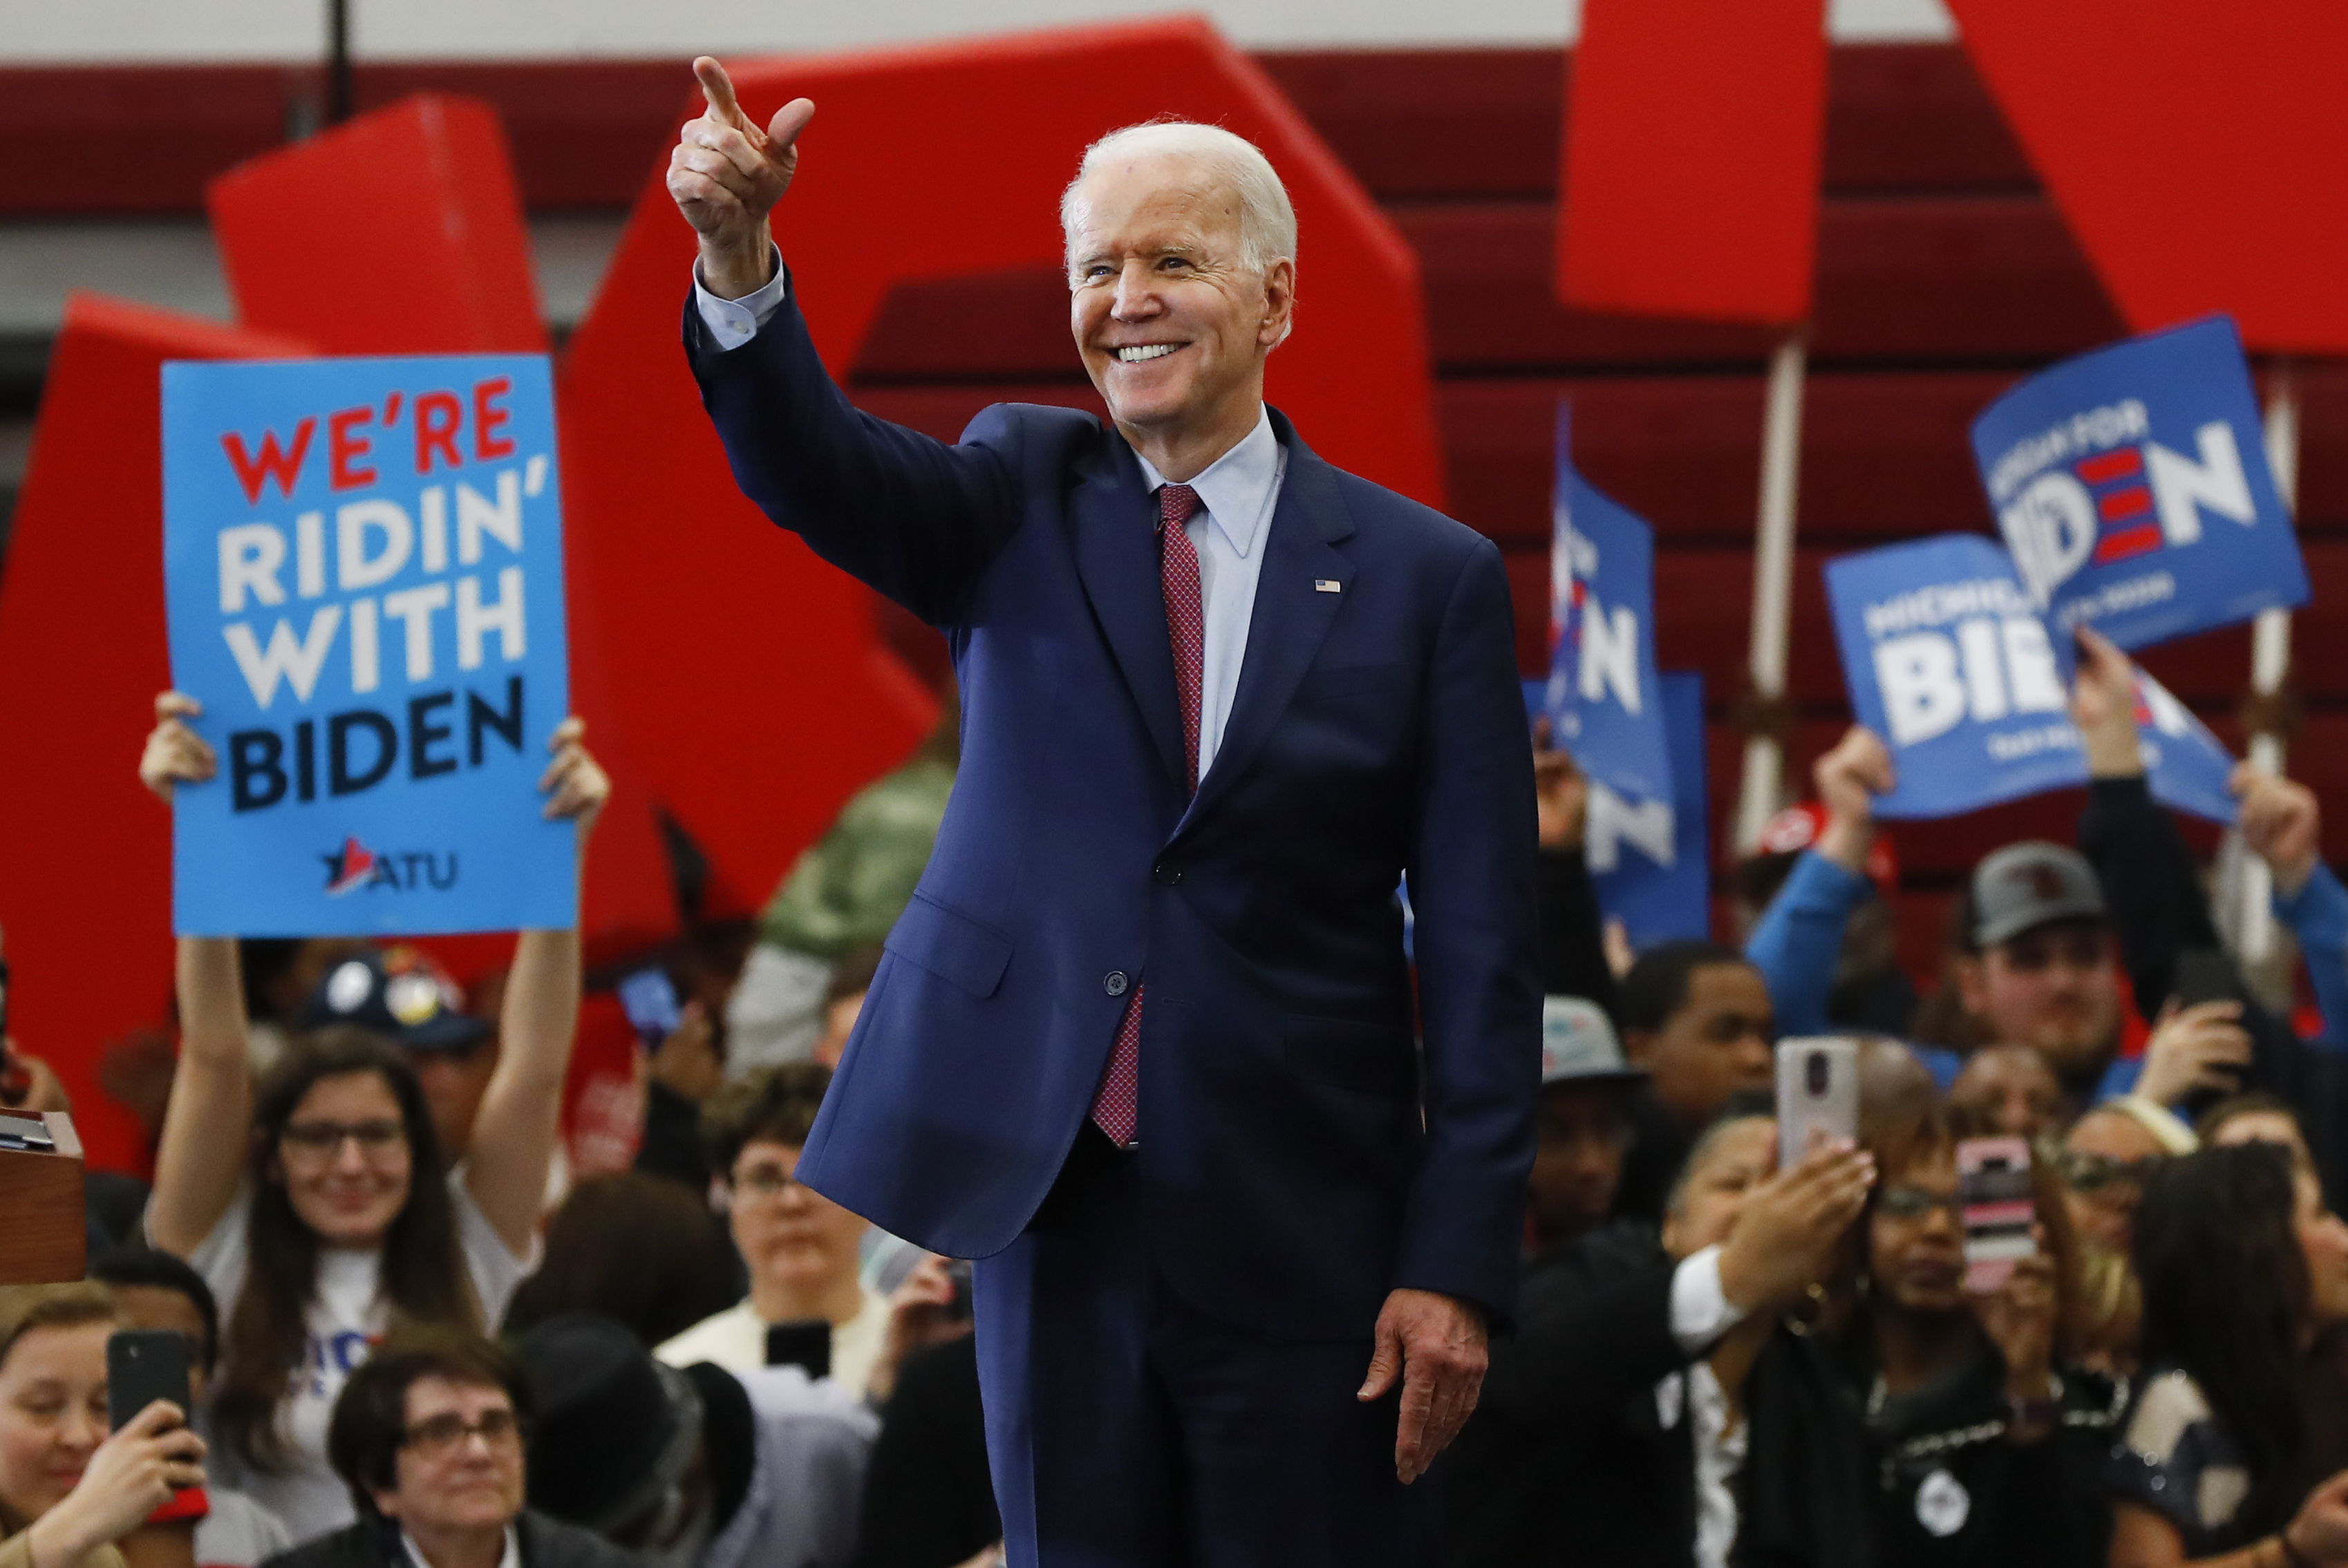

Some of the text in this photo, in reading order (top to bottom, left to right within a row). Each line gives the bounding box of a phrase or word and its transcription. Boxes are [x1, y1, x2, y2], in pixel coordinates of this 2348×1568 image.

[219, 373, 516, 508] WE'RE
[218, 454, 548, 614] RIDIN'
[2002, 420, 2258, 612] IDEN
[222, 565, 527, 710] WITH
[228, 675, 524, 814] BIDEN
[366, 852, 458, 892] ATU
